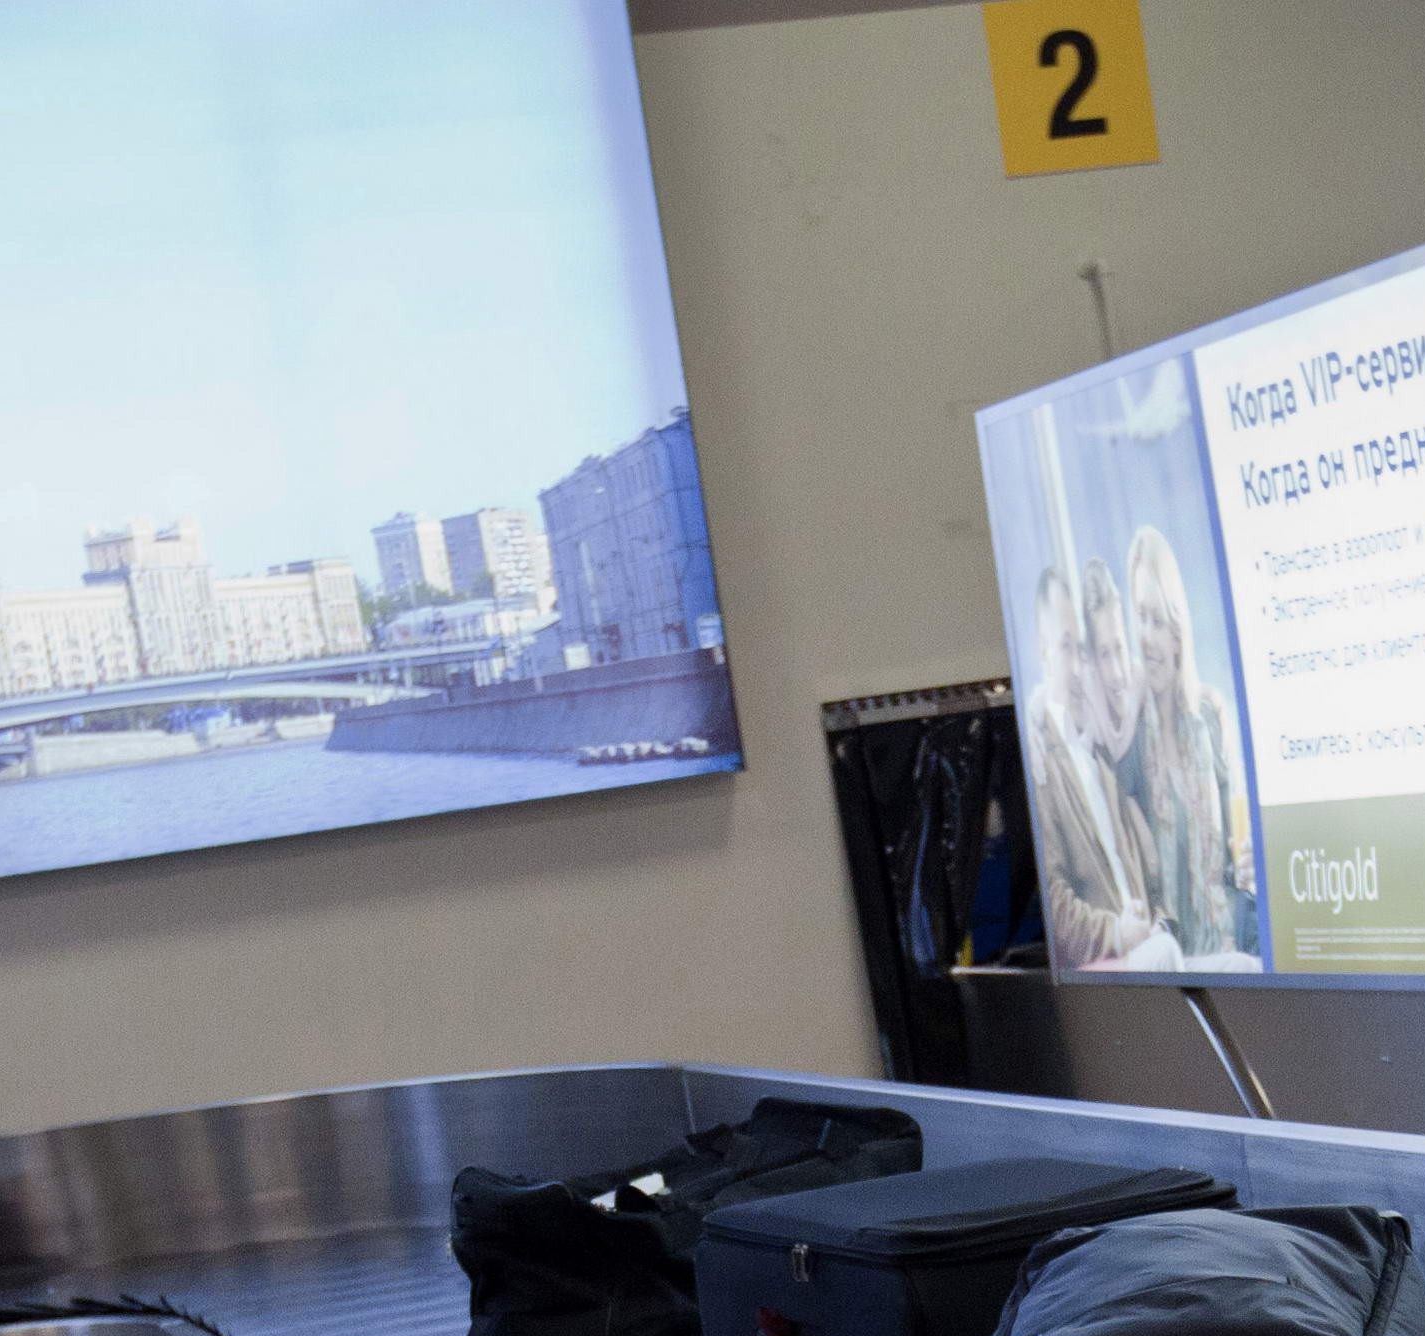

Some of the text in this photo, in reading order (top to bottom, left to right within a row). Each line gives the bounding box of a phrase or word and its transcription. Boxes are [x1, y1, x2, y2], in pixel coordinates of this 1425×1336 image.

[1037, 28, 1109, 141] 2
[1226, 377, 1298, 432] Когда
[1240, 459, 1313, 510] Когда
[1318, 446, 1349, 490] он
[1288, 846, 1380, 915] Citigold
